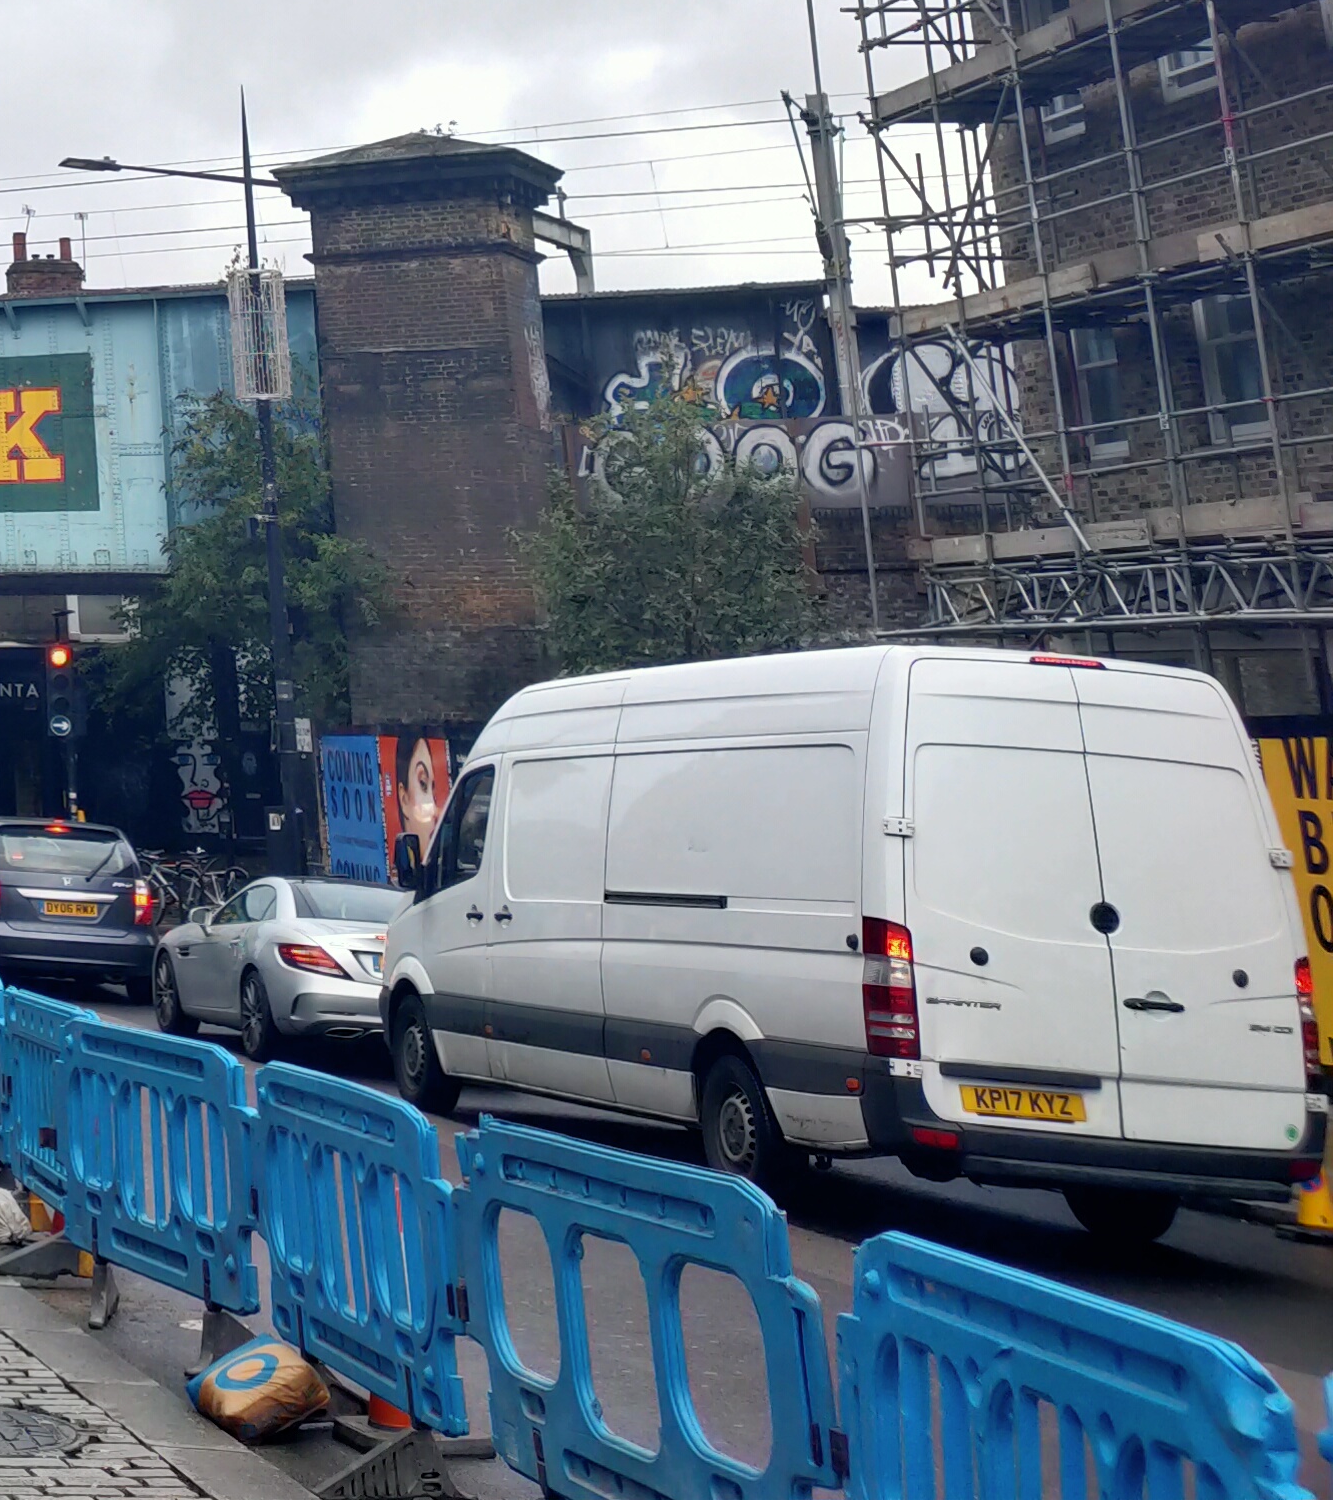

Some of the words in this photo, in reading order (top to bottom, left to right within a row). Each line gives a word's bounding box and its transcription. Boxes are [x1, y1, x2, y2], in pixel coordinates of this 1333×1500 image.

[327, 749, 373, 786] COMING
[1282, 736, 1333, 800] W
[331, 786, 377, 823] SOON
[974, 1088, 1022, 1112] KP17
[1029, 1091, 1074, 1116] KYZ
